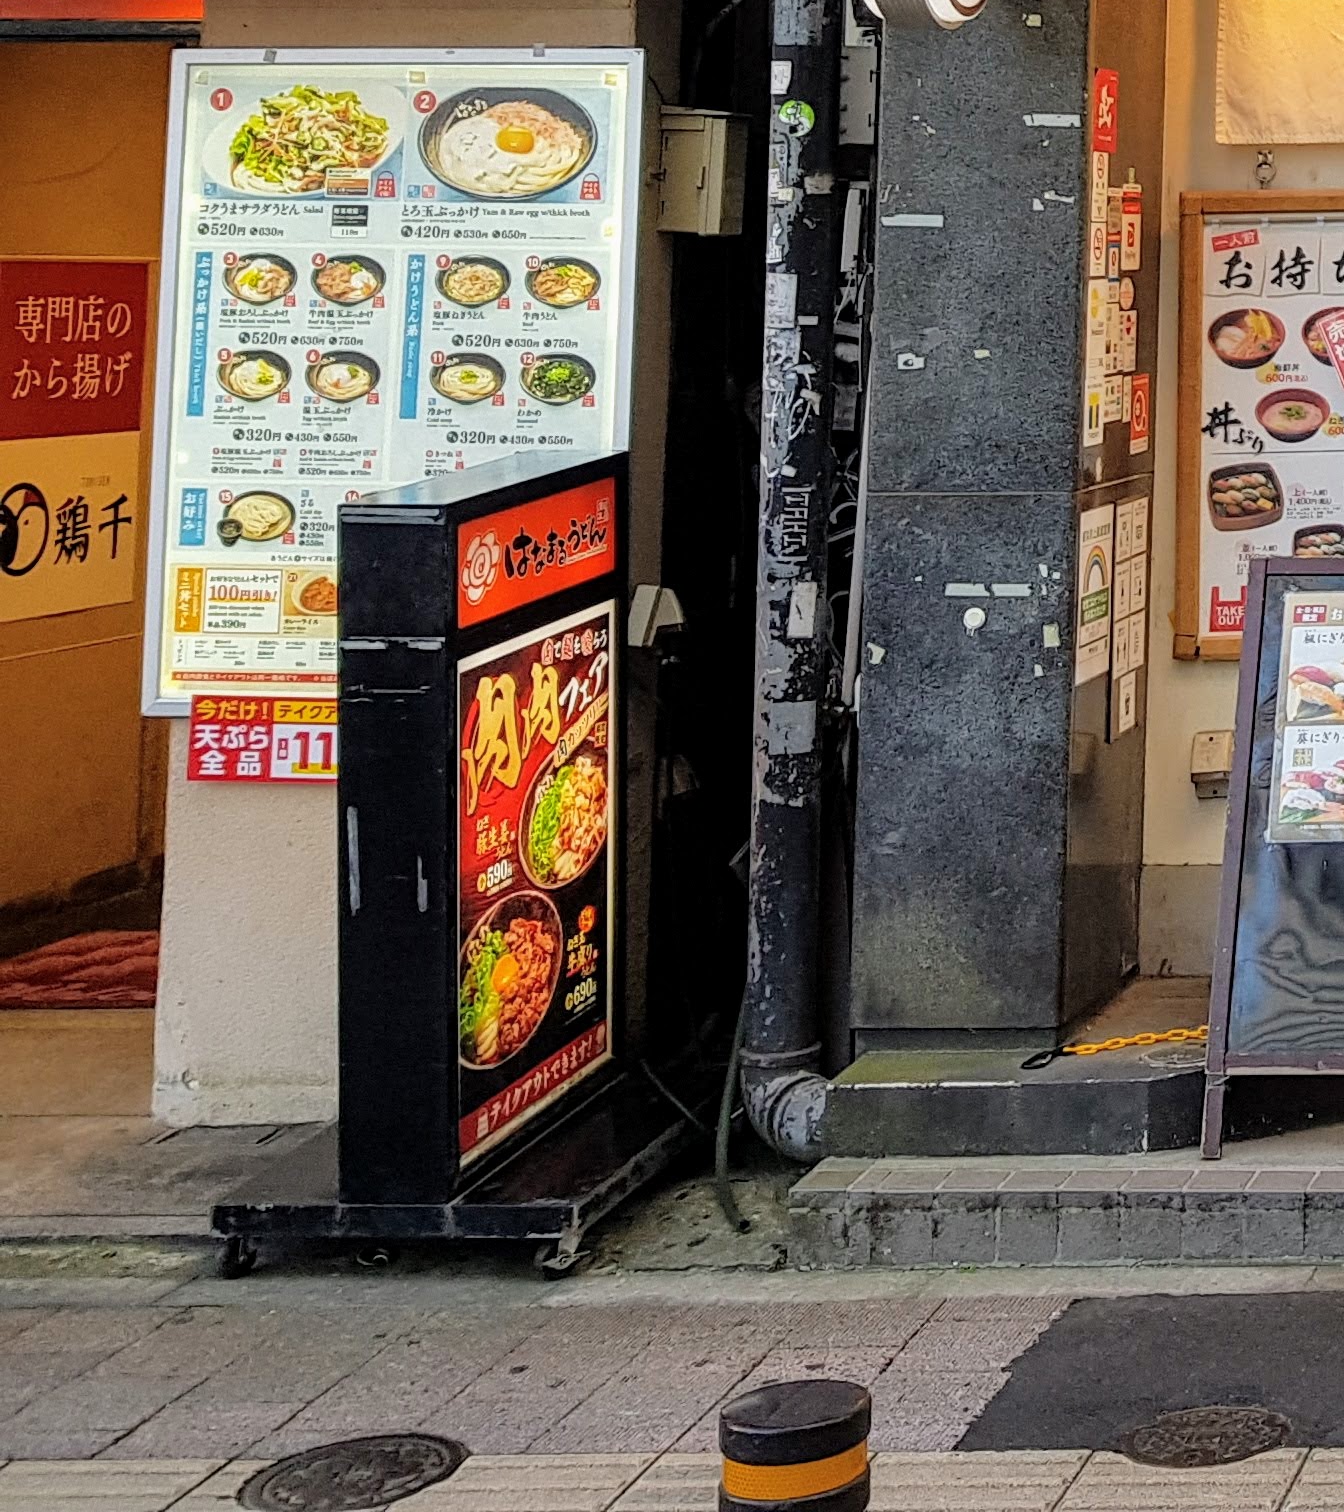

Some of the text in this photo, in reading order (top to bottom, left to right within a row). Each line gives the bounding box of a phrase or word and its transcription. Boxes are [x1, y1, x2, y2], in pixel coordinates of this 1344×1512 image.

[14, 294, 132, 344] 専門店の
[11, 351, 132, 400] から揚げ
[1202, 402, 1265, 454] 丼ぶり
[53, 494, 132, 566] 鶏千
[1216, 606, 1245, 617] TAKE
[1218, 615, 1242, 625] OUT
[196, 699, 269, 721] 今だけ!
[559, 651, 609, 722] フェア
[194, 724, 270, 750] 天ぷら
[198, 751, 262, 776] 全品
[489, 1034, 594, 1136] テイクアウトできます!
